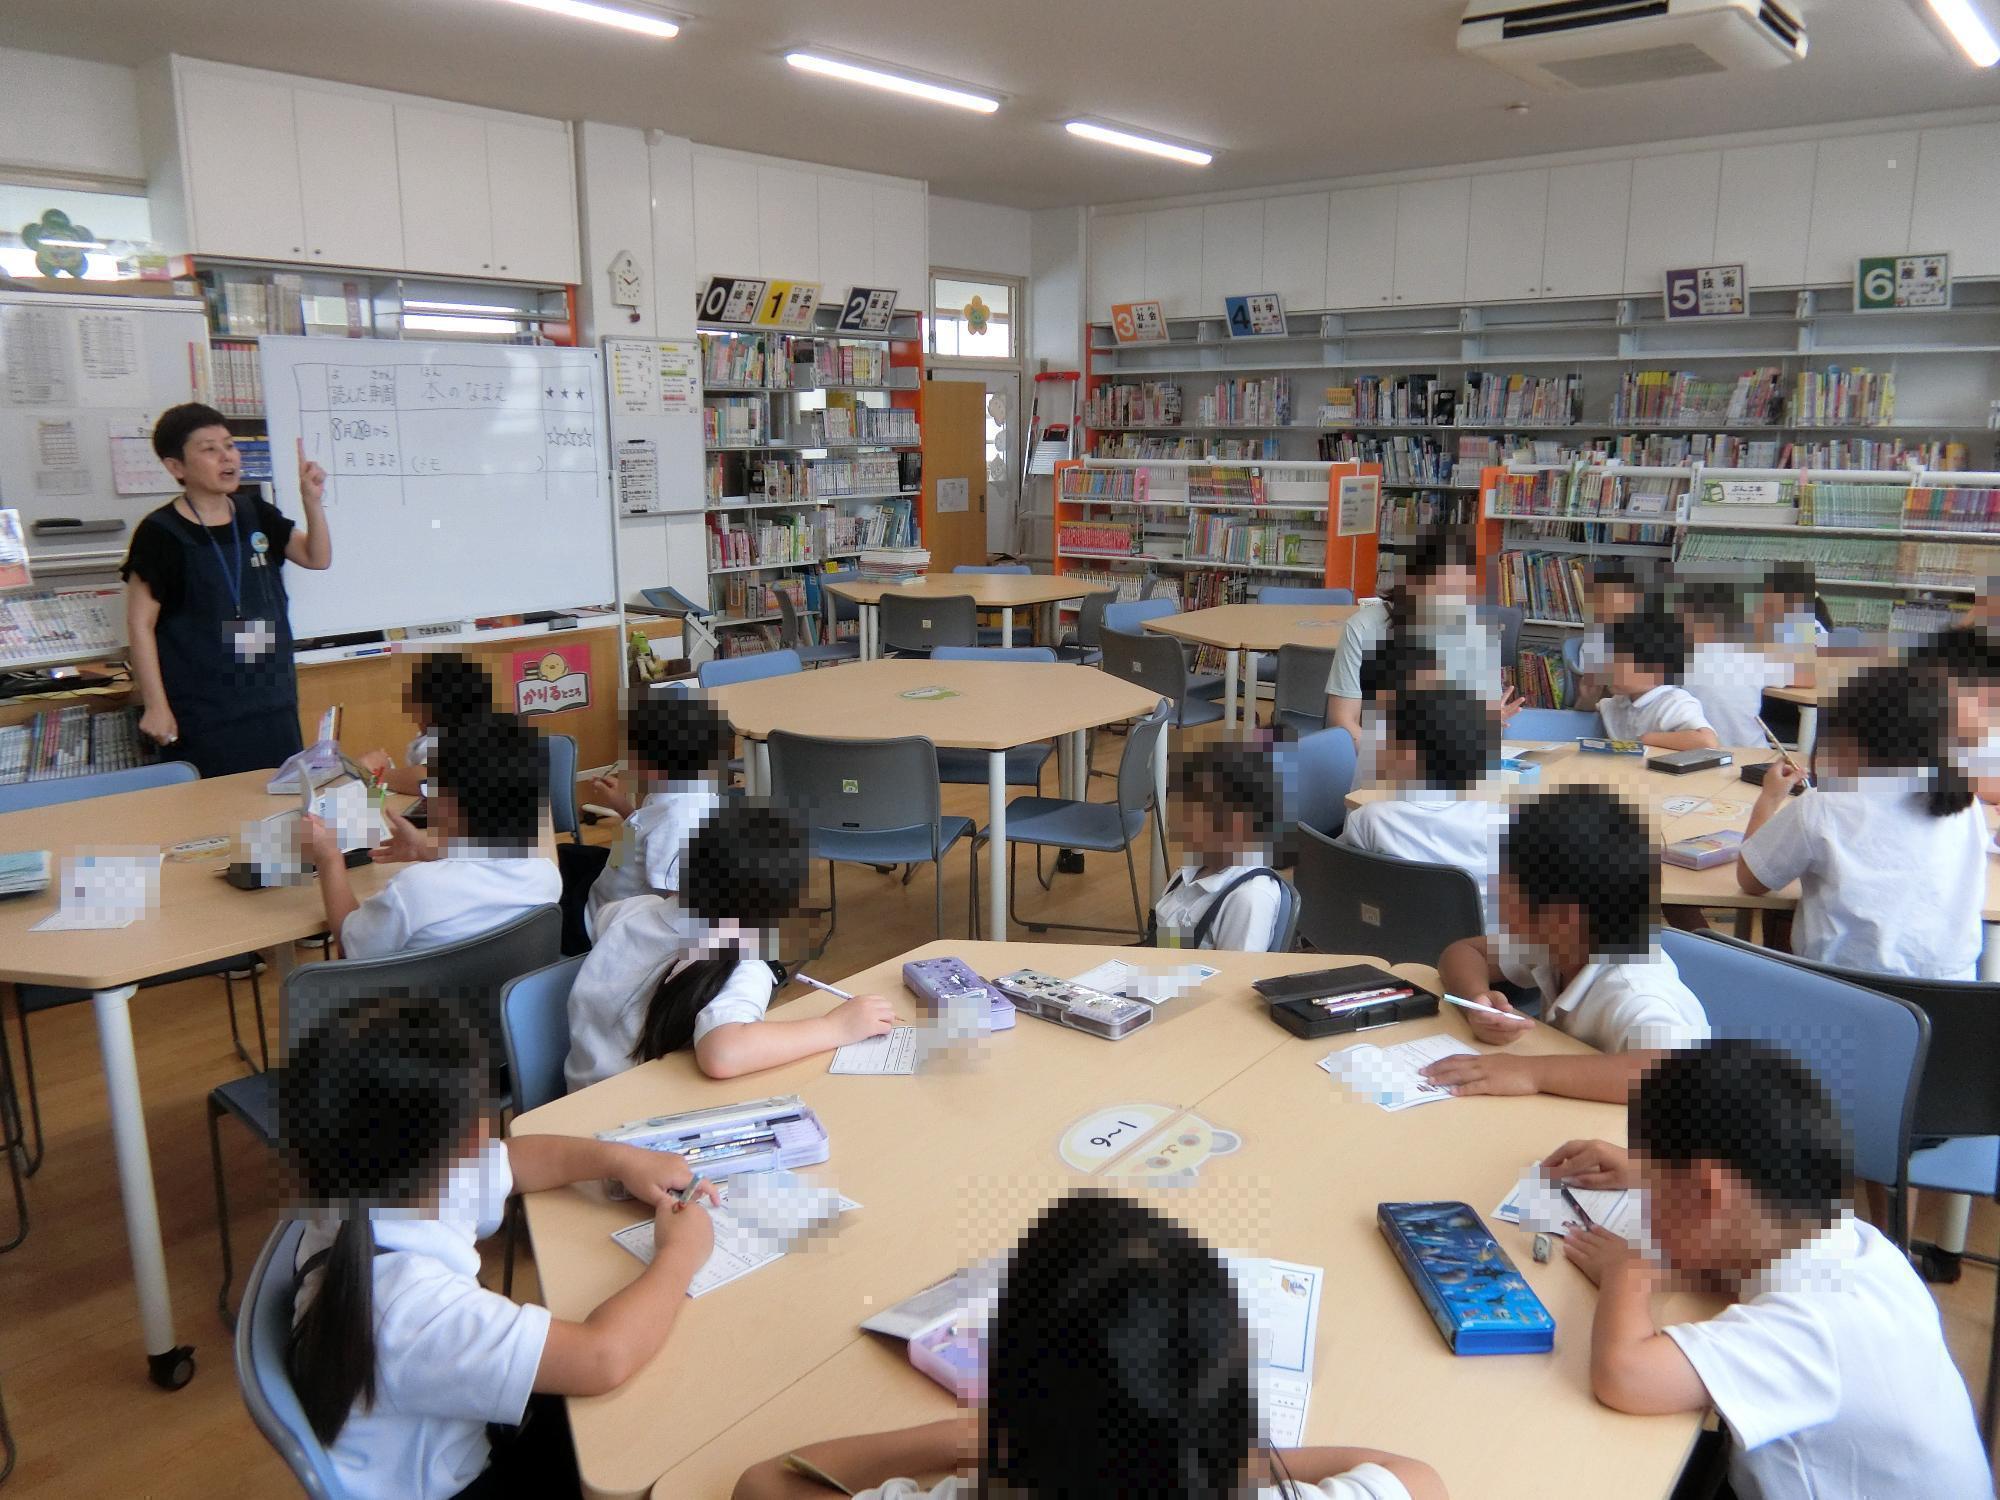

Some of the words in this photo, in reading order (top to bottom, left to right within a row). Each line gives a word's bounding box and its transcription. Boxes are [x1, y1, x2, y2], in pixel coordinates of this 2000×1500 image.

[1672, 278, 1697, 310] 5
[1864, 267, 1893, 301] 6
[706, 286, 727, 315] 0
[770, 291, 784, 318] 1
[845, 296, 866, 323] 2
[1117, 312, 1135, 337] 3
[1136, 310, 1157, 321] 社会
[1232, 304, 1250, 329] 4
